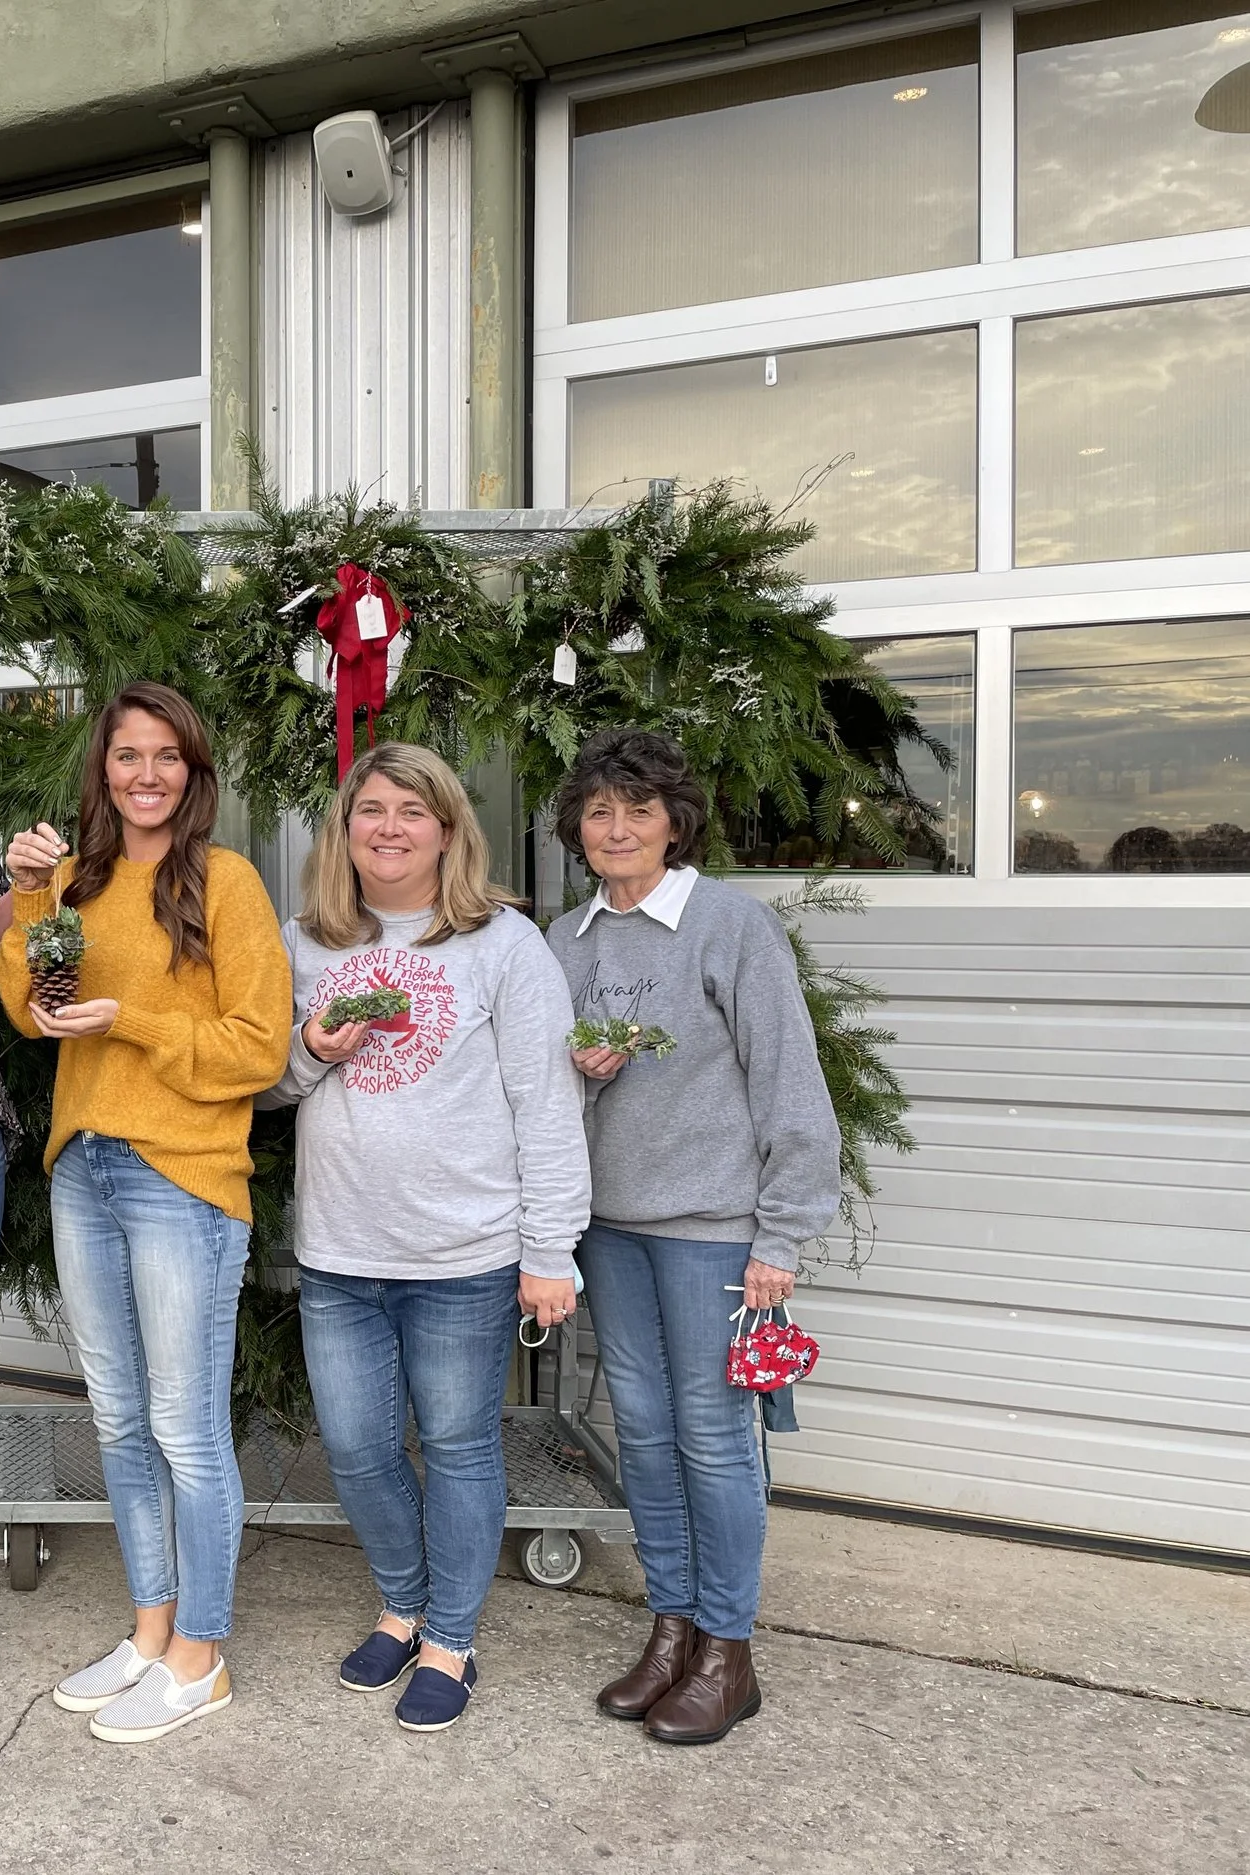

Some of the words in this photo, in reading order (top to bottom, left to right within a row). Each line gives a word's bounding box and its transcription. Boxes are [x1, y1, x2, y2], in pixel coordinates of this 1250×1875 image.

[393, 949, 431, 970] RED
[400, 964, 447, 982] nosed
[350, 1052, 396, 1073] ANCER
